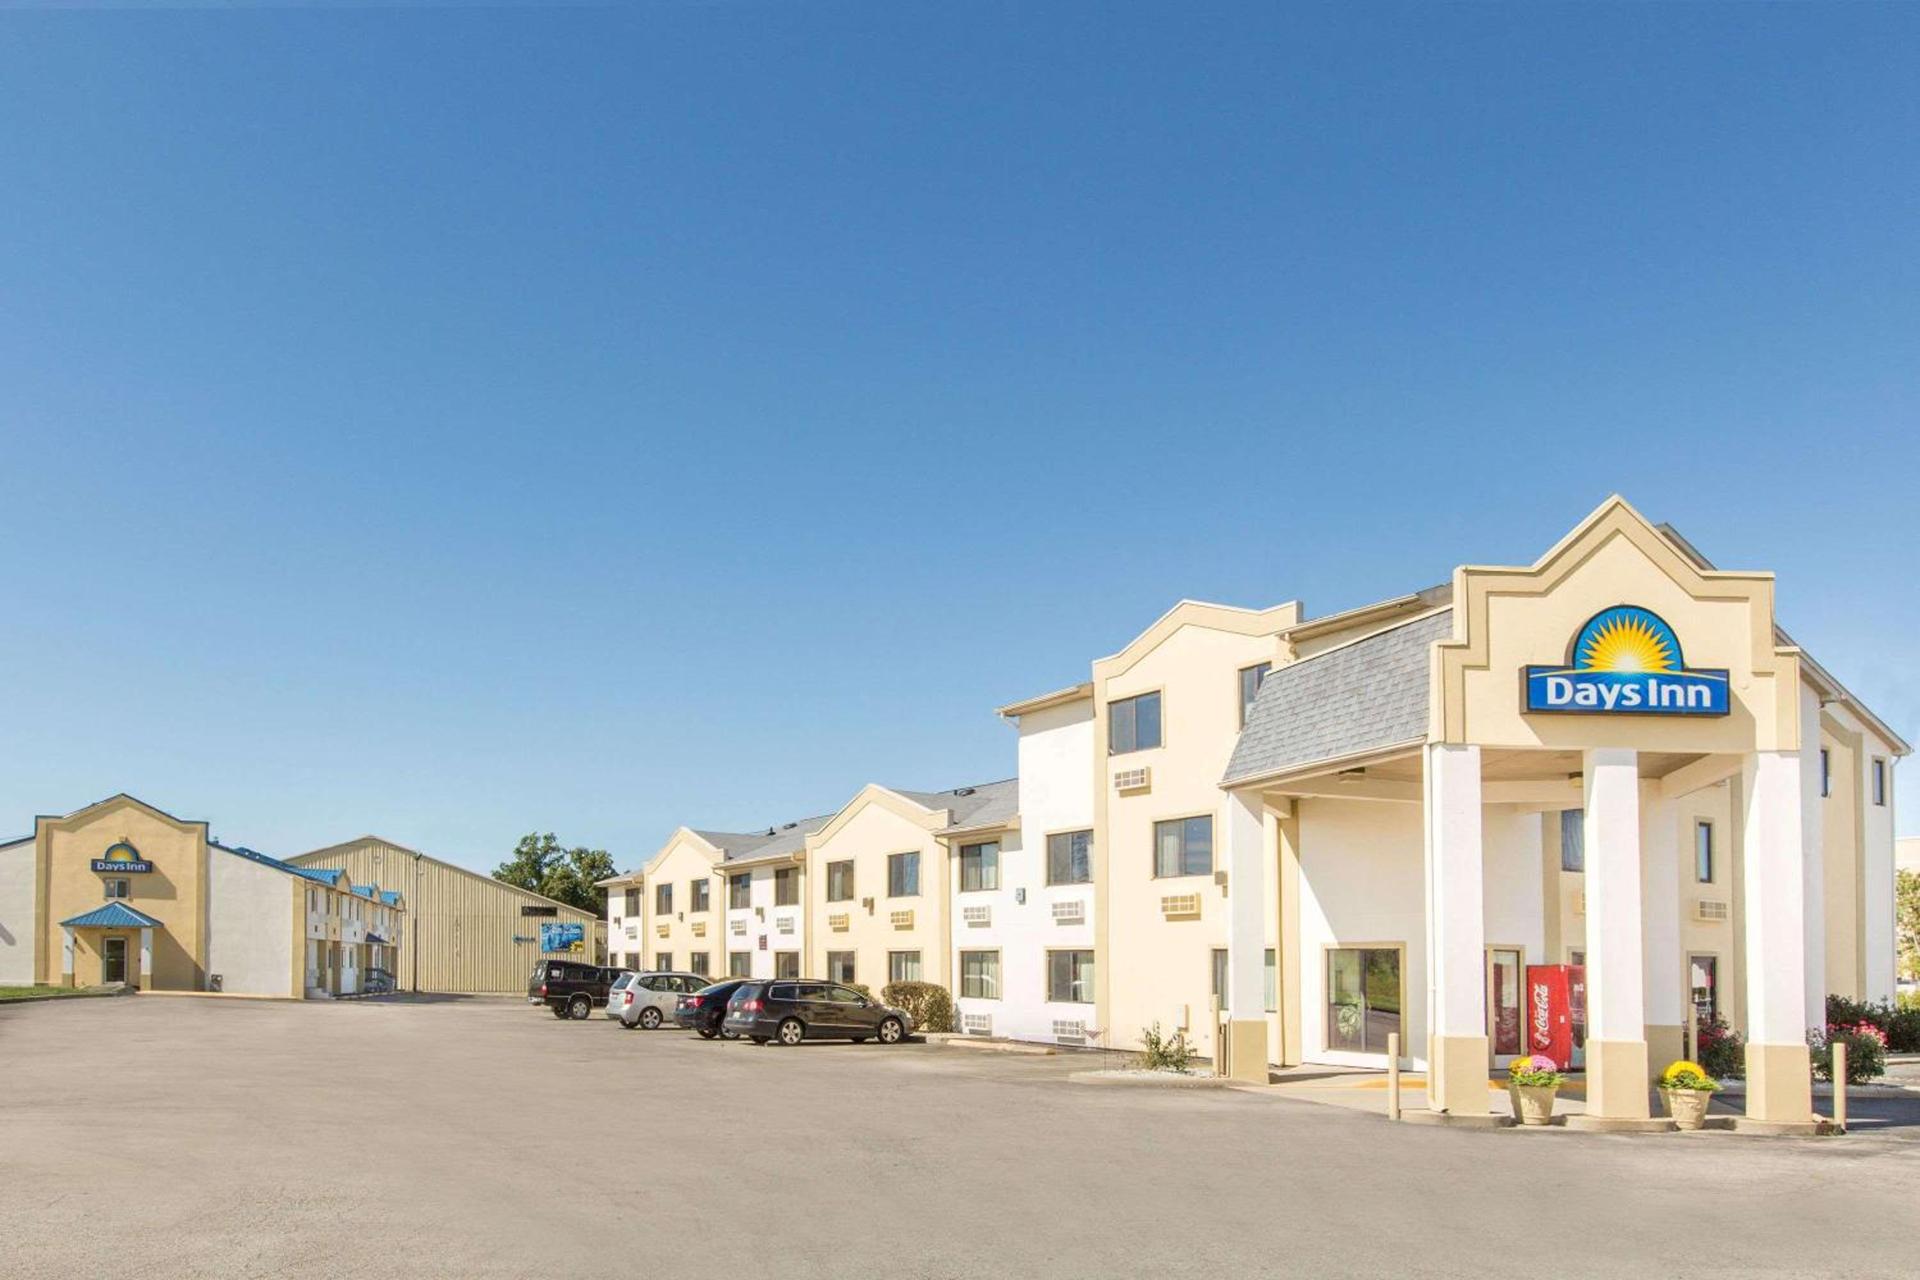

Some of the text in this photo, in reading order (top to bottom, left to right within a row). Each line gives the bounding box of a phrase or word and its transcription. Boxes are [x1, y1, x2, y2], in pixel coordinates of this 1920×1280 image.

[1547, 677, 1712, 710] Days Inn
[96, 861, 146, 872] Days Inn
